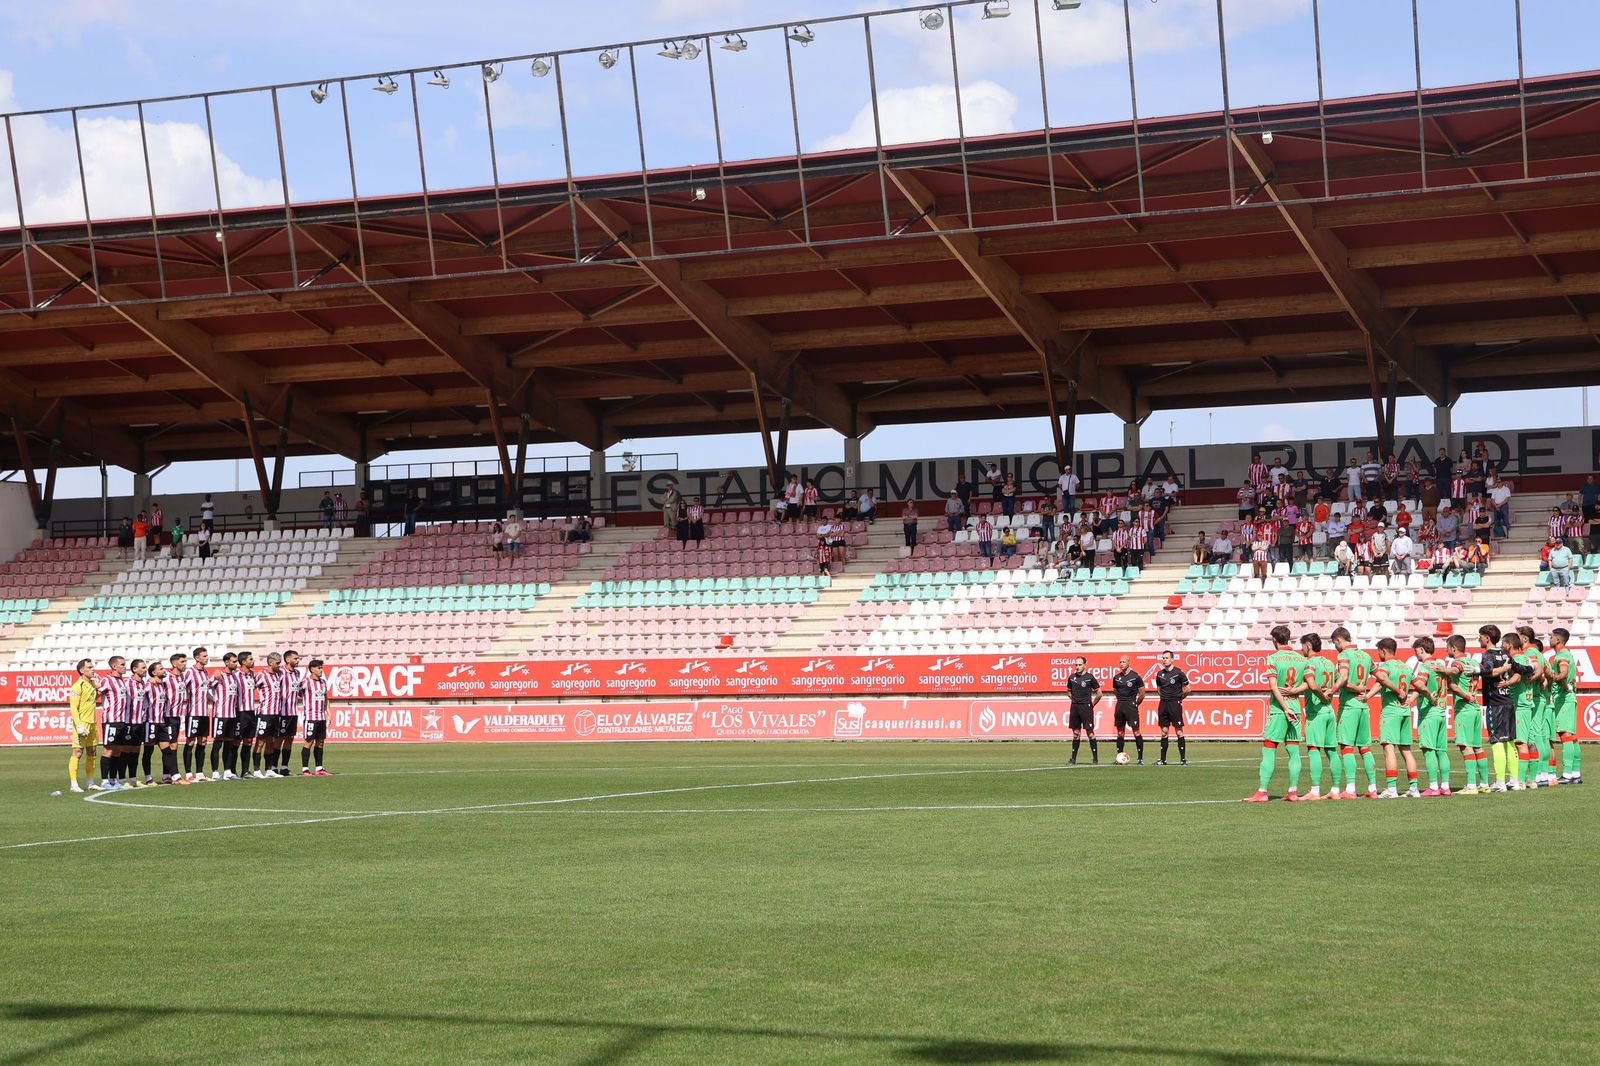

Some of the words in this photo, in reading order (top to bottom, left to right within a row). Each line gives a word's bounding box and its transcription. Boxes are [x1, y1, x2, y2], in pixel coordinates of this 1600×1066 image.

[880, 448, 1224, 502] MUNICIPAL
[1464, 431, 1561, 476] DE
[1186, 653, 1233, 667] Clínica
[16, 672, 72, 687] FUNDACIÓN
[390, 666, 425, 697] CF
[551, 678, 600, 691] sangregorio
[606, 677, 656, 690] sangregorio
[669, 677, 720, 690] sangregorio
[726, 675, 778, 689] sangregorio
[791, 674, 845, 688] sangregorio
[850, 674, 905, 688] sangregorio
[918, 673, 974, 687] sangregorio
[980, 672, 1037, 687] sangregorio
[1286, 667, 1297, 688] 8
[1398, 674, 1408, 693] 6
[437, 680, 485, 692] sangregorio
[490, 679, 539, 691] sangregorio
[336, 710, 351, 727] DE
[355, 710, 371, 727] LA
[375, 709, 413, 727] PLATA
[484, 714, 566, 726] VALDERADUEY
[597, 713, 632, 726] ELOY
[634, 710, 693, 725] ÁLVAREZ
[838, 717, 859, 730] Susi
[865, 717, 962, 732] casqueriasusi.es
[1001, 711, 1058, 727] INNOVA
[1210, 709, 1253, 729] Chef
[327, 729, 348, 739] Vino
[352, 729, 402, 741] (Zamora)
